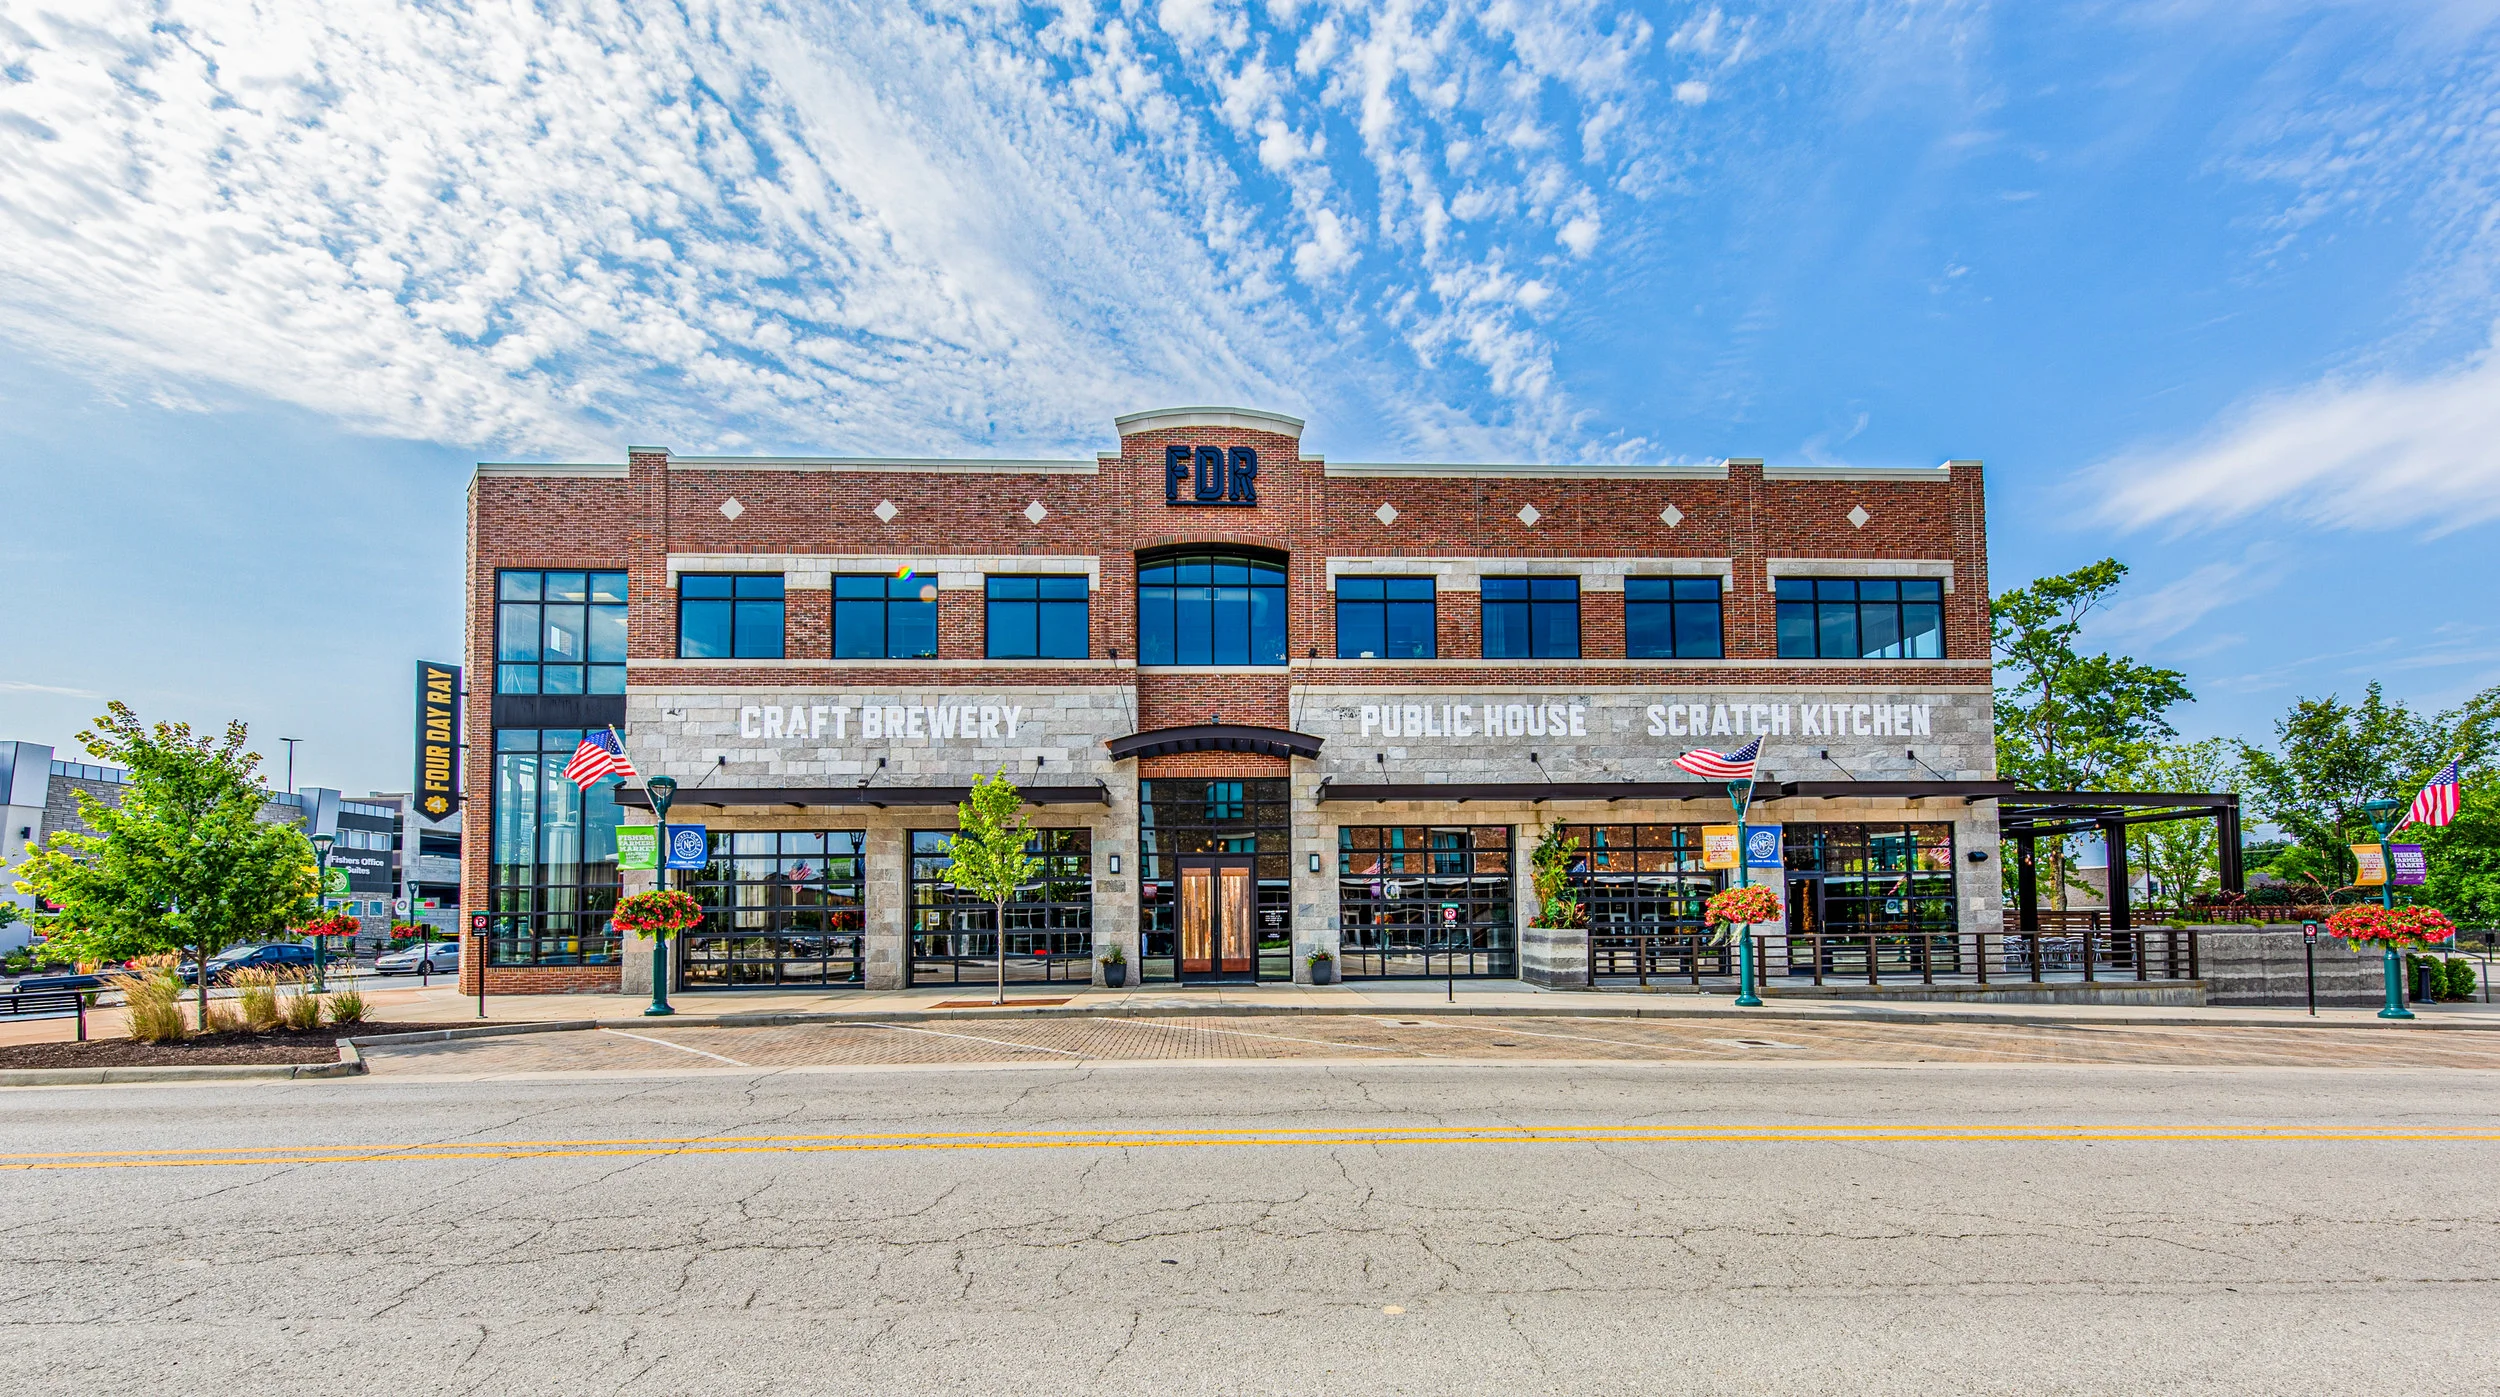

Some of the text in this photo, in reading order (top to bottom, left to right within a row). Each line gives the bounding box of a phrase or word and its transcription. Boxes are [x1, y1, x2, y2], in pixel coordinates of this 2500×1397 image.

[1166, 446, 1258, 500] FDR
[425, 667, 452, 792] FOUR DAY RAY
[740, 705, 1022, 739] CRAFT BREWERY
[1361, 703, 1587, 738] PUBLIC HOUSE
[1647, 703, 1931, 737] SCRATCH KITCHEN
[430, 799, 442, 810] 4
[331, 855, 384, 867] Fishers Office
[683, 839, 695, 851] NP
[346, 866, 370, 875] Suites
